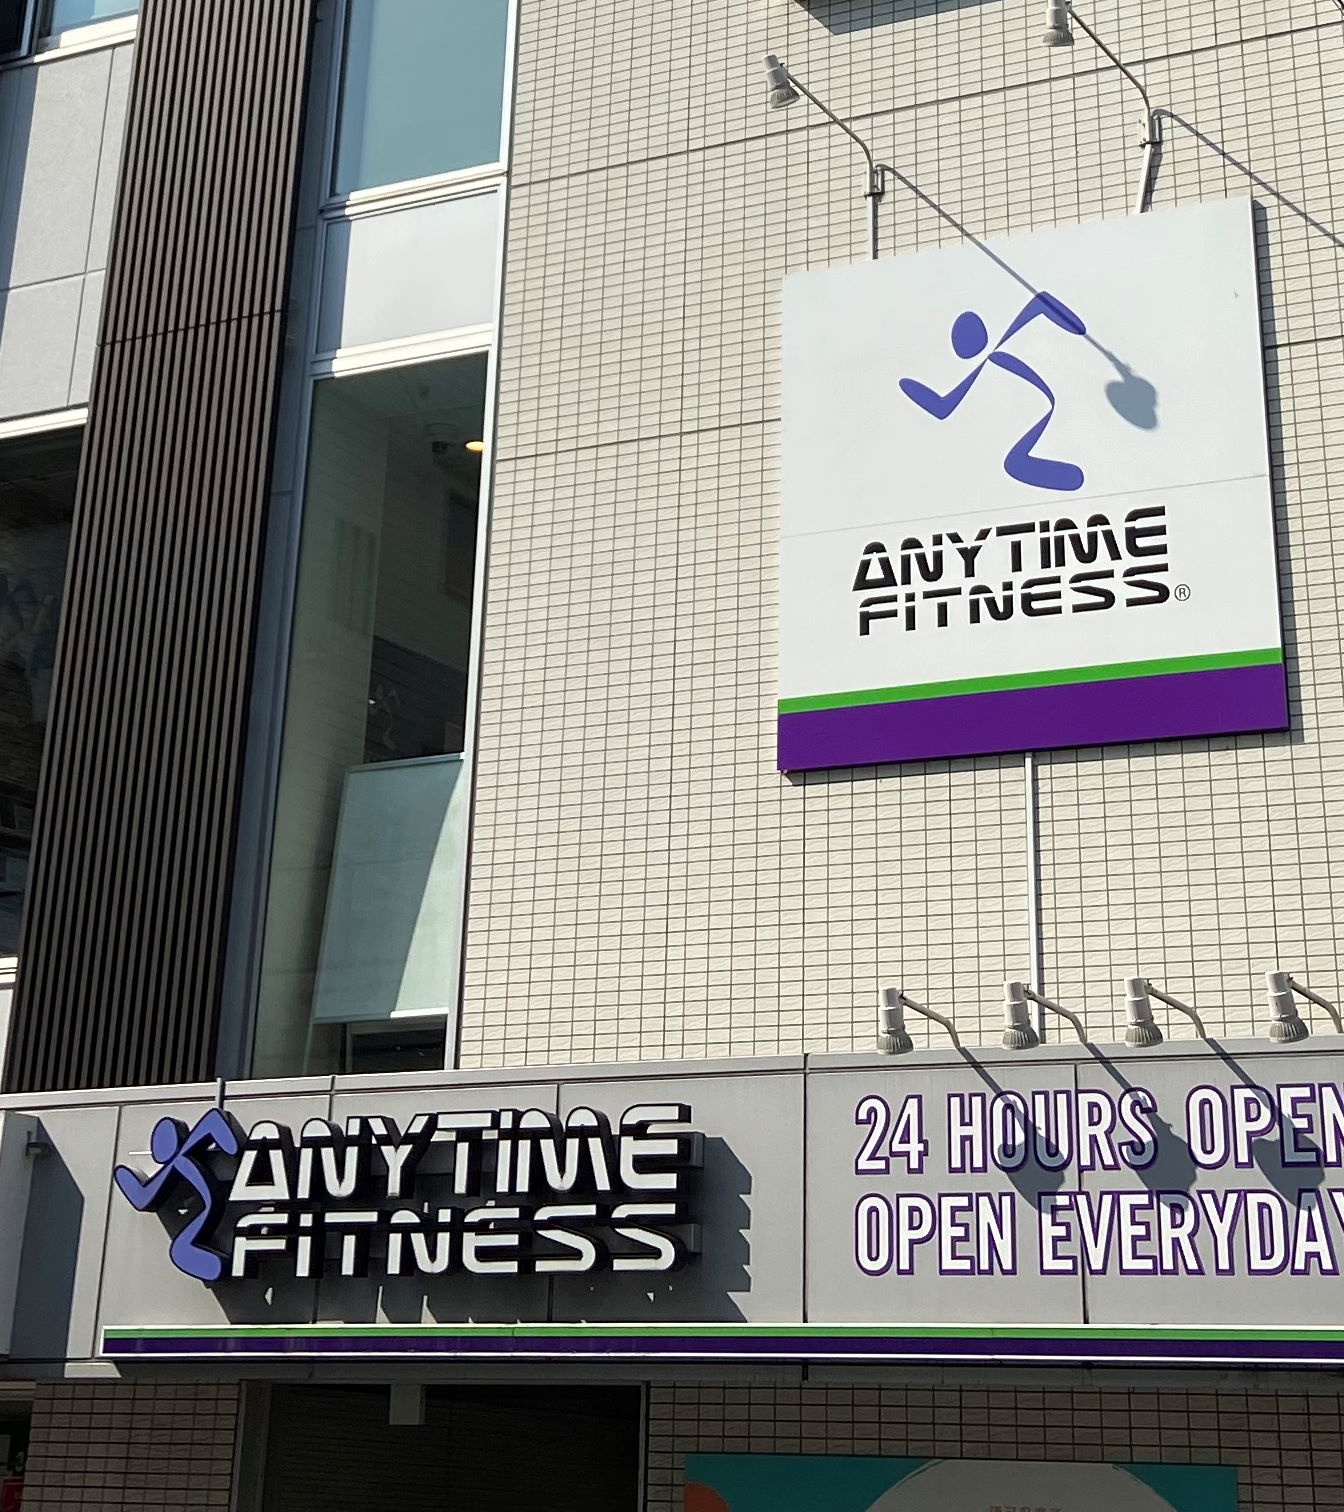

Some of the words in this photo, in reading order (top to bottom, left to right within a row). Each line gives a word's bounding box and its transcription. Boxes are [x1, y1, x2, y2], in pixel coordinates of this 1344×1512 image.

[852, 505, 1168, 592] ANYTIME
[229, 1103, 693, 1202] ANYTIME
[856, 1093, 928, 1175] 24
[946, 1087, 1157, 1174] HOURS
[231, 1203, 679, 1279] FITNESS
[856, 1191, 1017, 1276] OPEN
